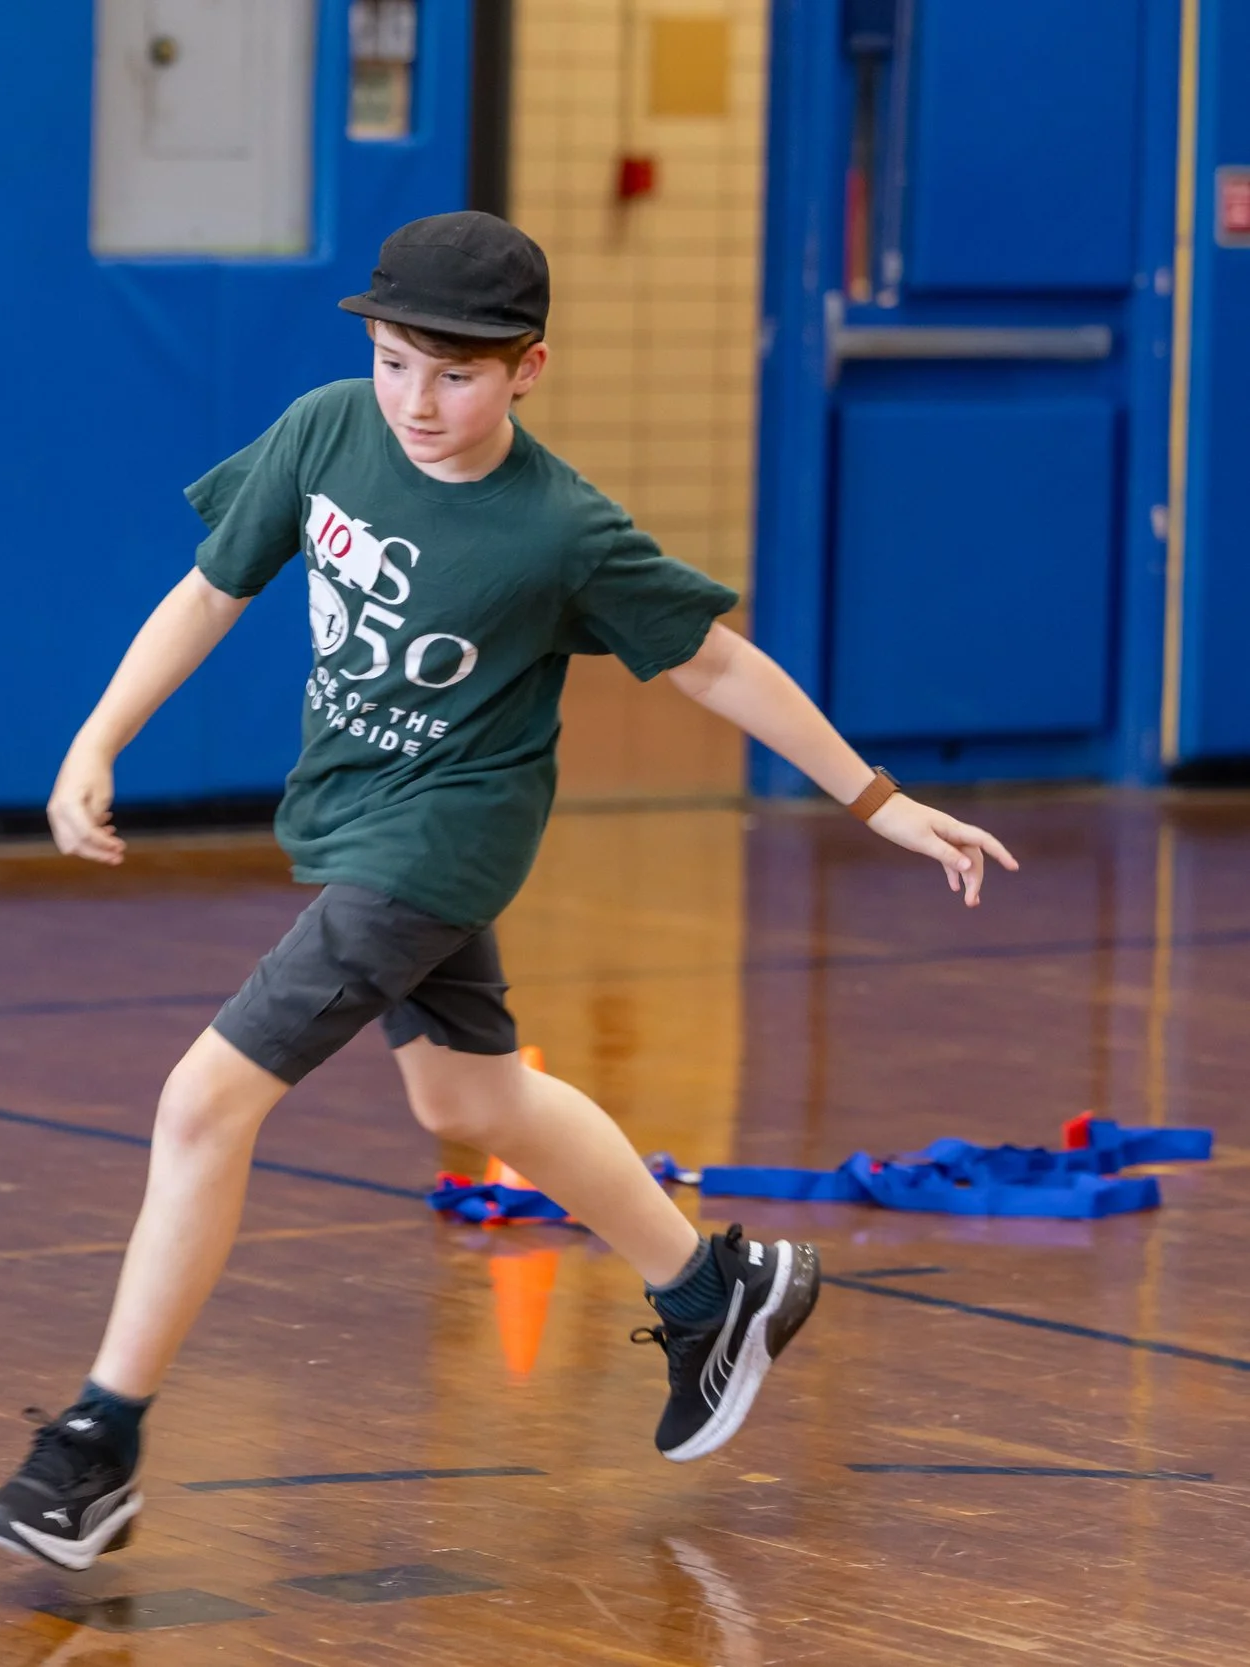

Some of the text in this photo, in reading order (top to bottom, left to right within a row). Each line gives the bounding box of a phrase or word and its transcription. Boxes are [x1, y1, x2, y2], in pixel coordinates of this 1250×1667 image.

[317, 512, 352, 558] 10
[305, 678, 422, 757] OUTHSIDE
[346, 692, 378, 713] OF
[389, 707, 449, 739] THE
